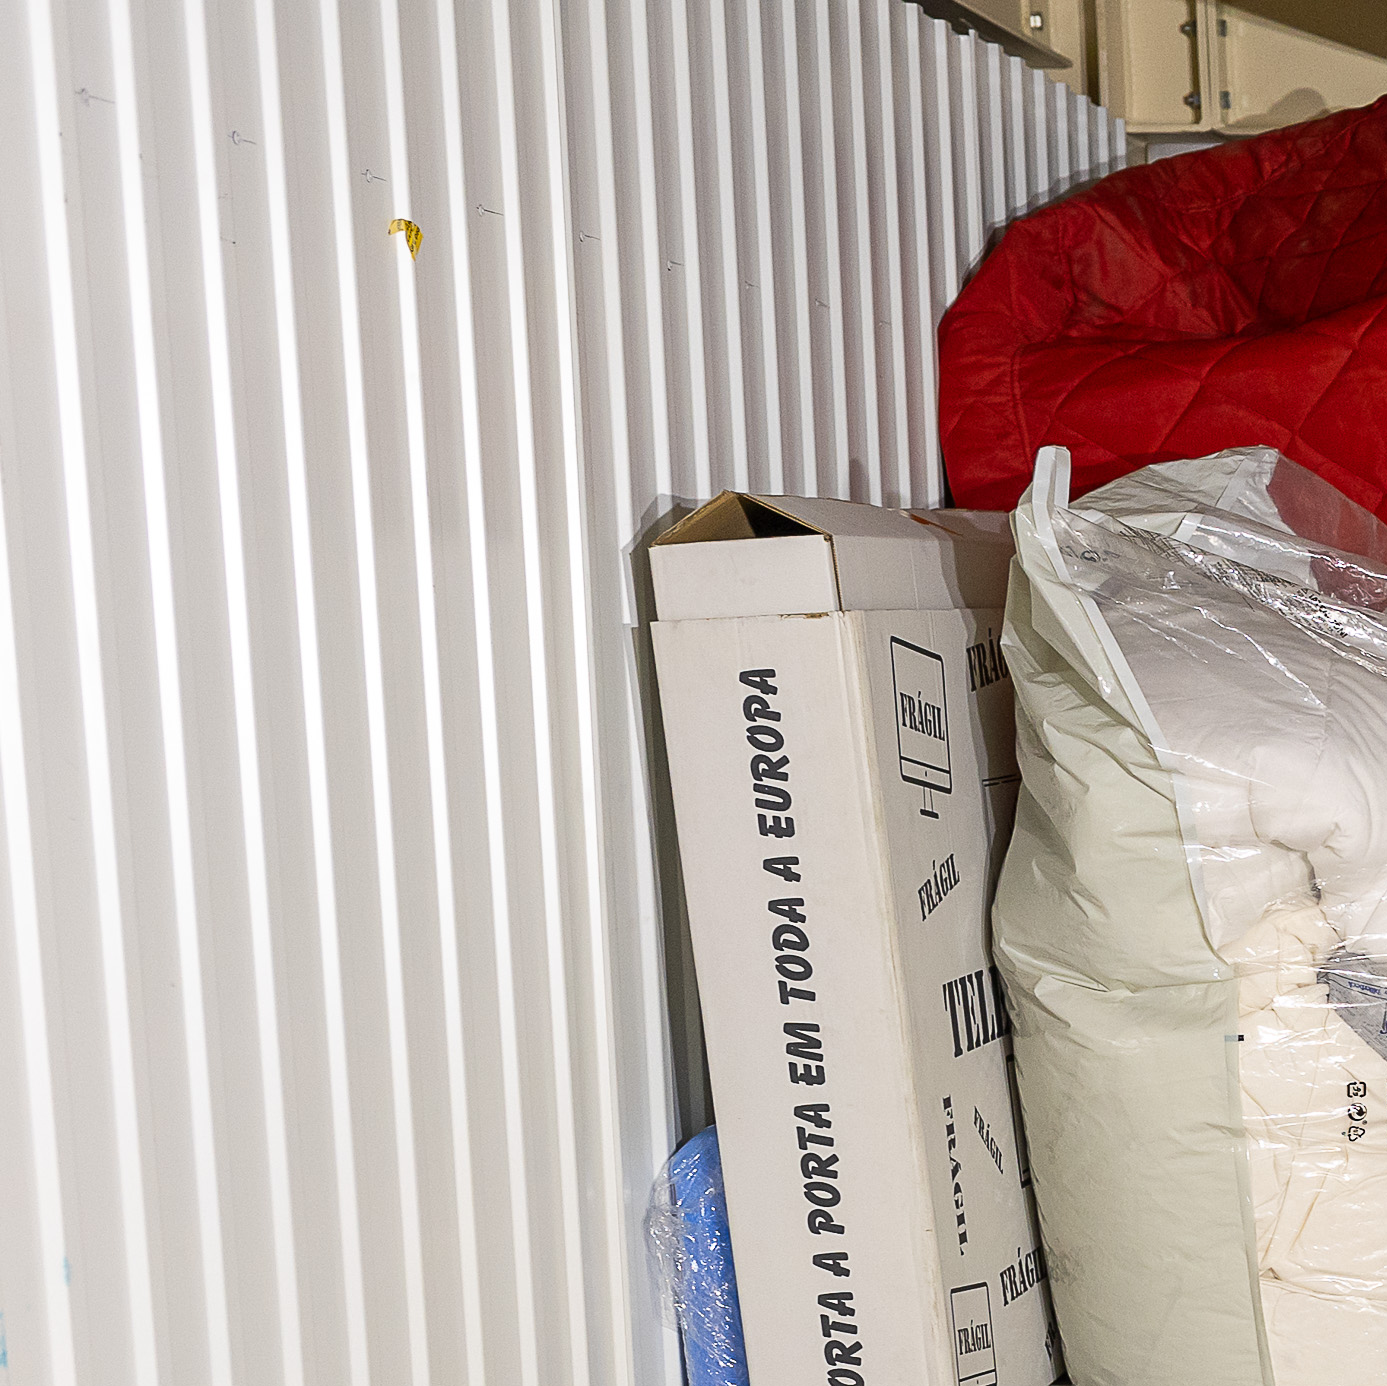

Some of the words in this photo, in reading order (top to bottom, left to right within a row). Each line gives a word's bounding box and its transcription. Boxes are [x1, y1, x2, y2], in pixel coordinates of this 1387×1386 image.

[899, 690, 946, 742] FRÁGIL
[738, 667, 796, 840] EUROPA
[763, 856, 802, 882] A
[918, 853, 961, 923] FRÁGIL
[767, 896, 818, 1006] TODA
[784, 1022, 828, 1087] EM
[794, 1102, 847, 1236] PORTA
[974, 1104, 1004, 1176] FRÁGIL
[812, 1250, 850, 1278] A
[957, 1319, 992, 1356] FRÁGIL
